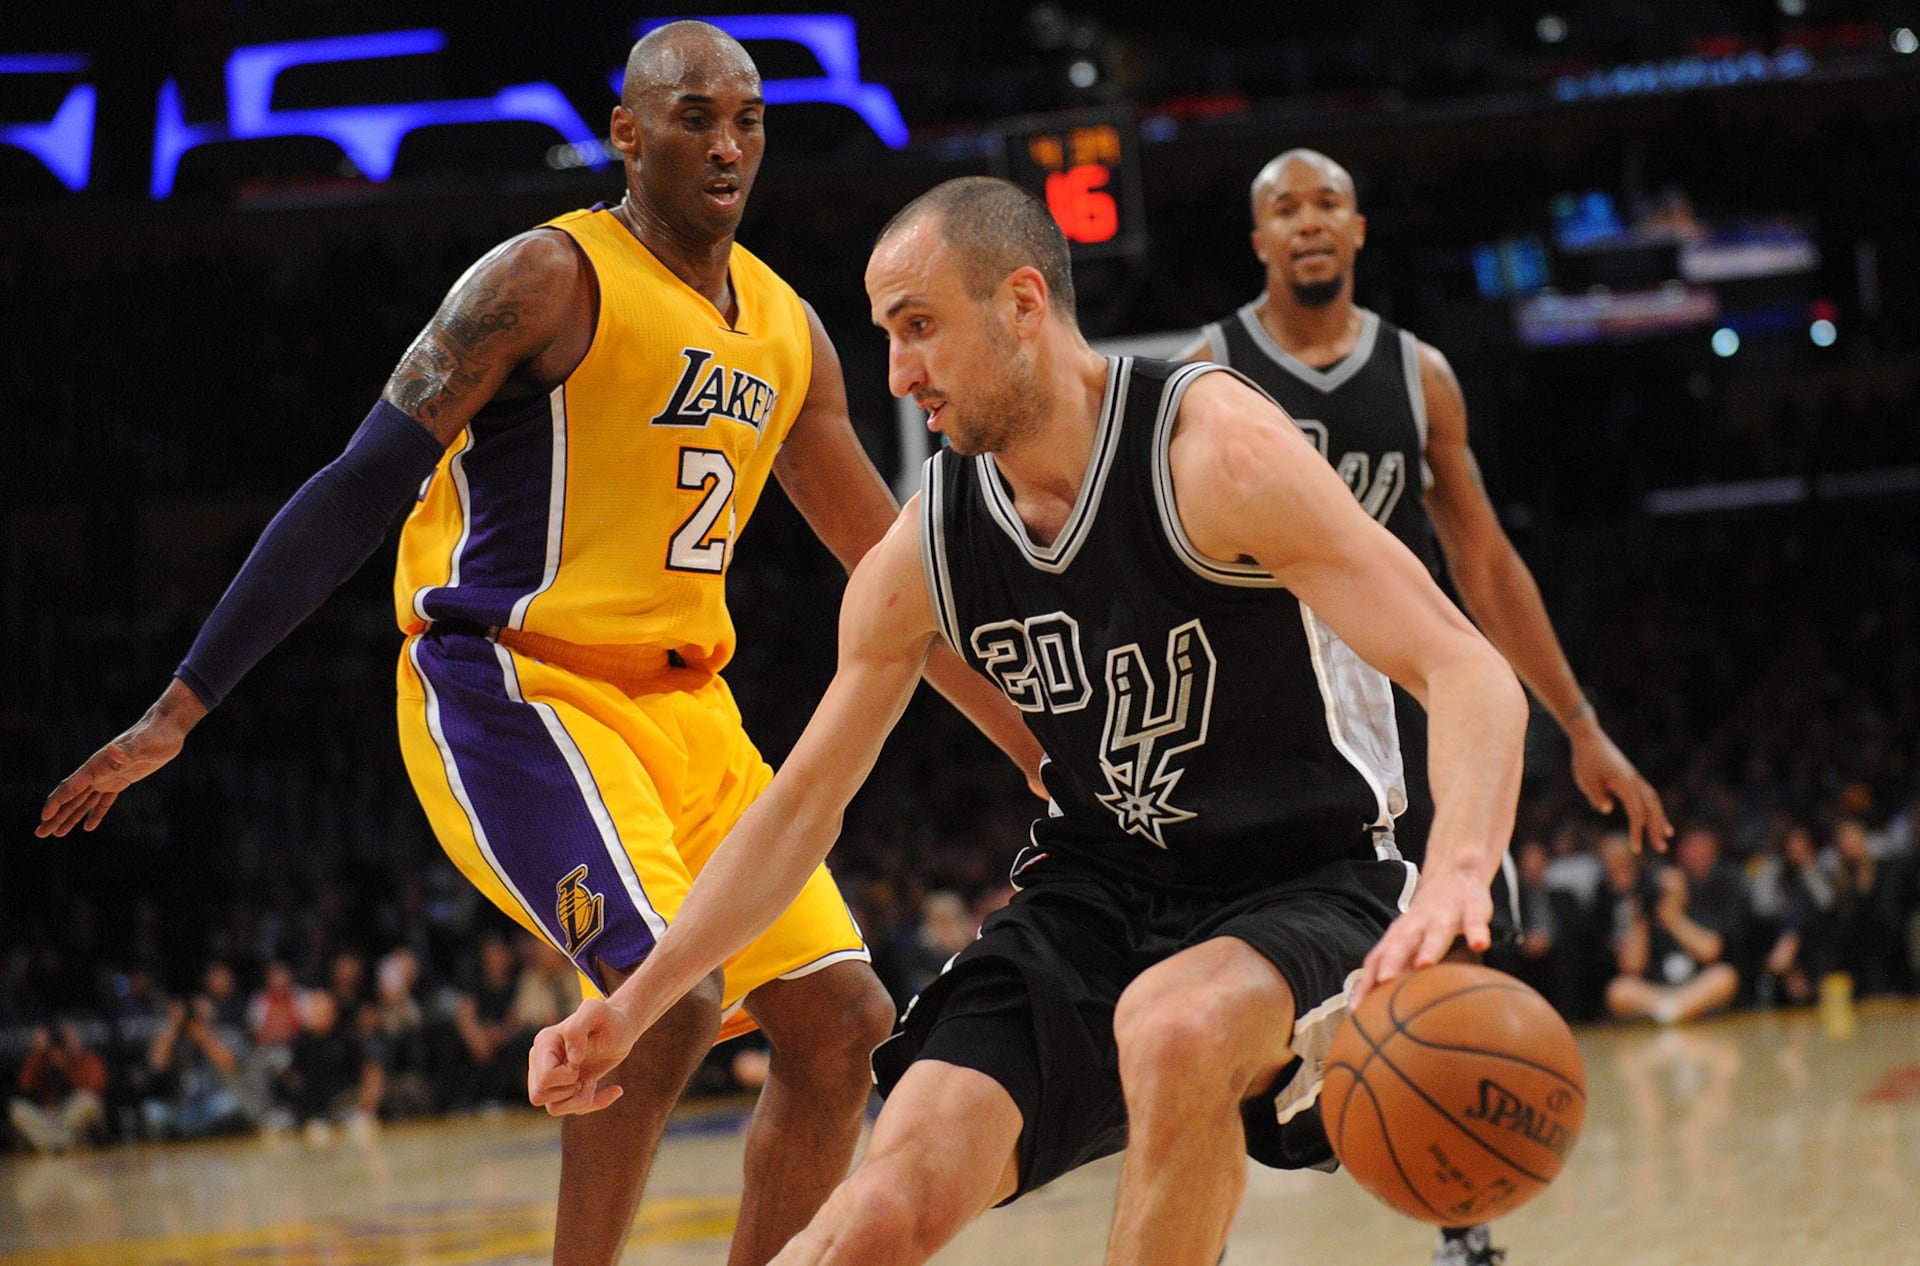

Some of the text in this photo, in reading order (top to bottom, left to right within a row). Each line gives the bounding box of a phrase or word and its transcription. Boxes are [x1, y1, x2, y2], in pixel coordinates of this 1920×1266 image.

[650, 347, 778, 442] LAKER
[665, 445, 736, 575] 2
[970, 611, 1093, 714] 20
